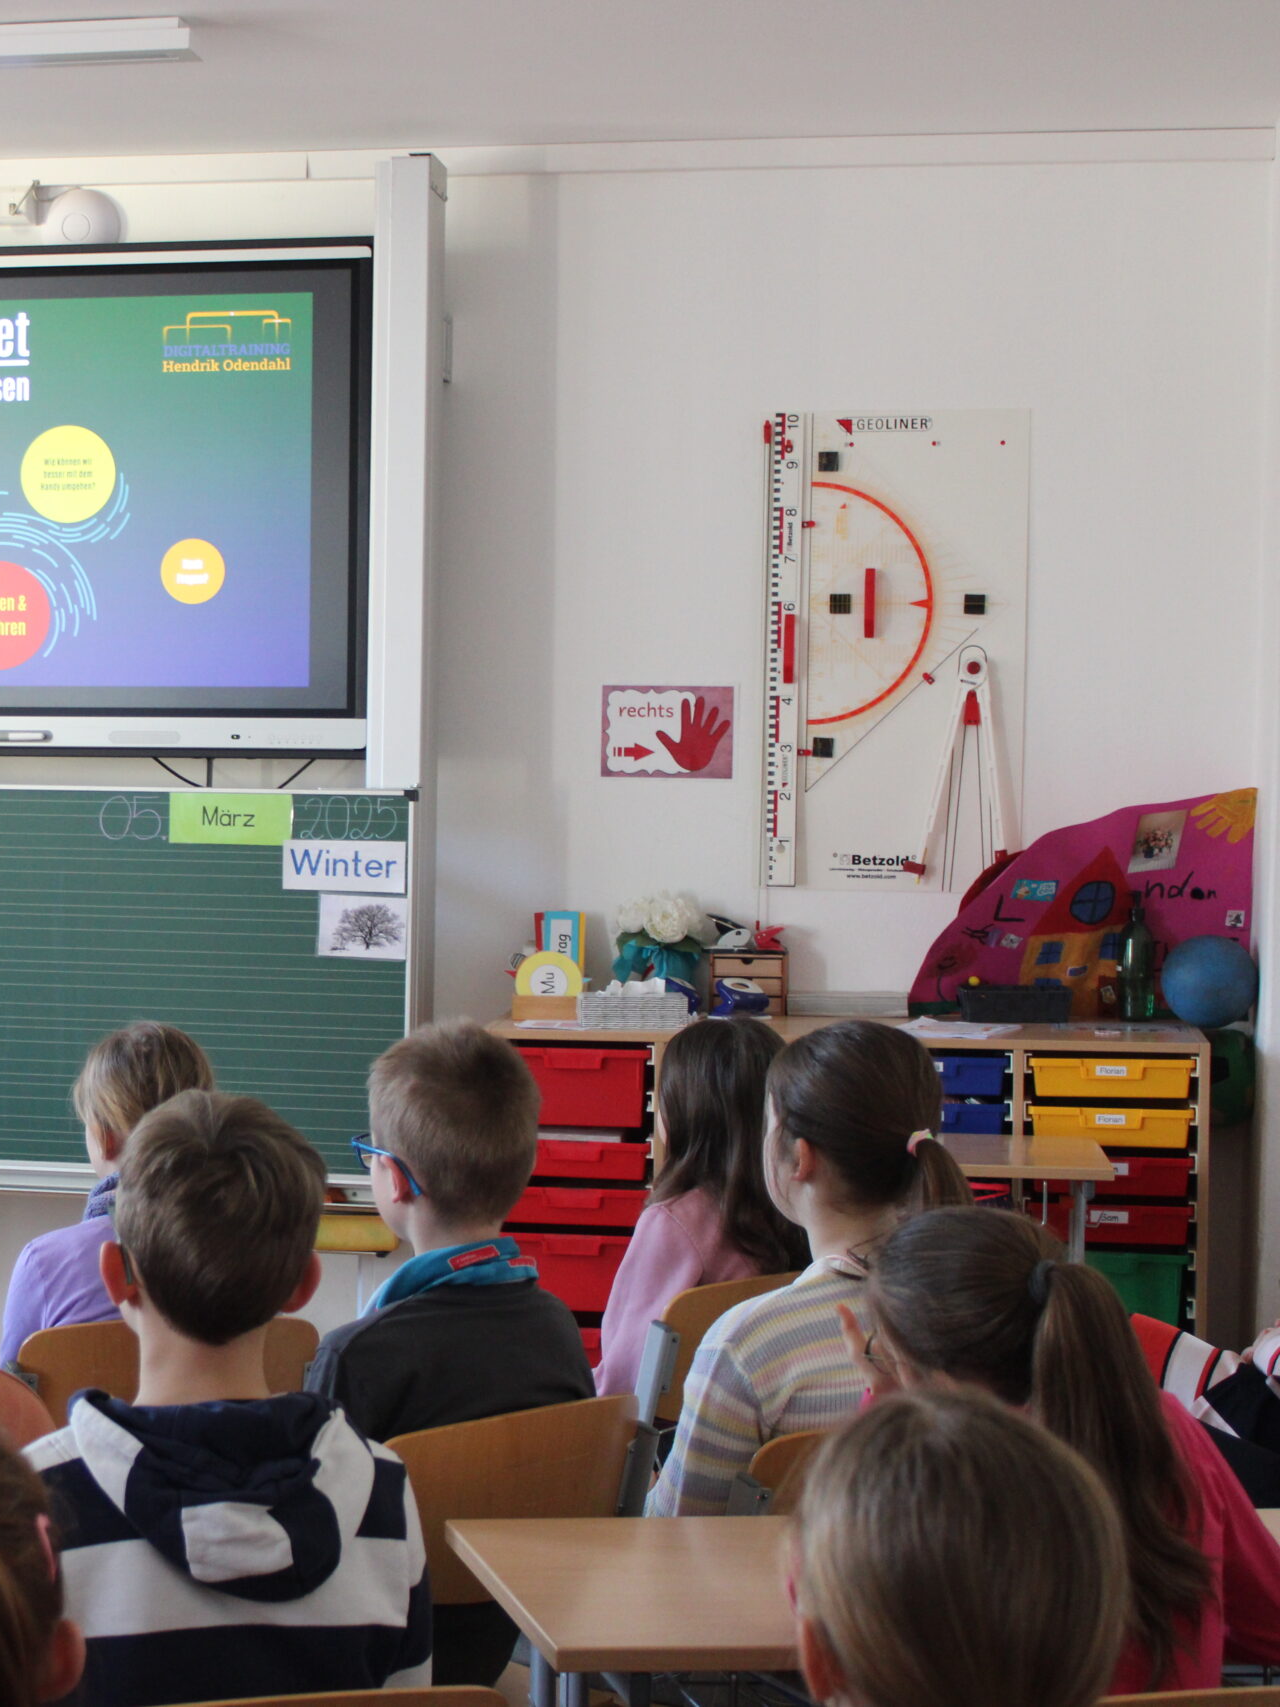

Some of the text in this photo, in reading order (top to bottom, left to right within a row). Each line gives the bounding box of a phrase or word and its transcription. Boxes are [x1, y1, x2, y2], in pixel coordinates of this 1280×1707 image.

[163, 343, 291, 357] DIGITALTRAINING
[162, 357, 291, 372] Hendrik Odendahl
[787, 414, 799, 429] 10
[857, 418, 928, 430] GEOLINER
[786, 508, 797, 517] 8
[784, 555, 796, 565] 7
[17, 594, 27, 611] &
[783, 602, 795, 611] 6
[781, 698, 793, 706] 4
[618, 702, 674, 718] rechts
[780, 744, 792, 752] 3
[779, 792, 791, 801] 2
[201, 806, 256, 828] März
[299, 796, 399, 841] 2025
[290, 848, 397, 879] Winter
[540, 972, 555, 994] Mu
